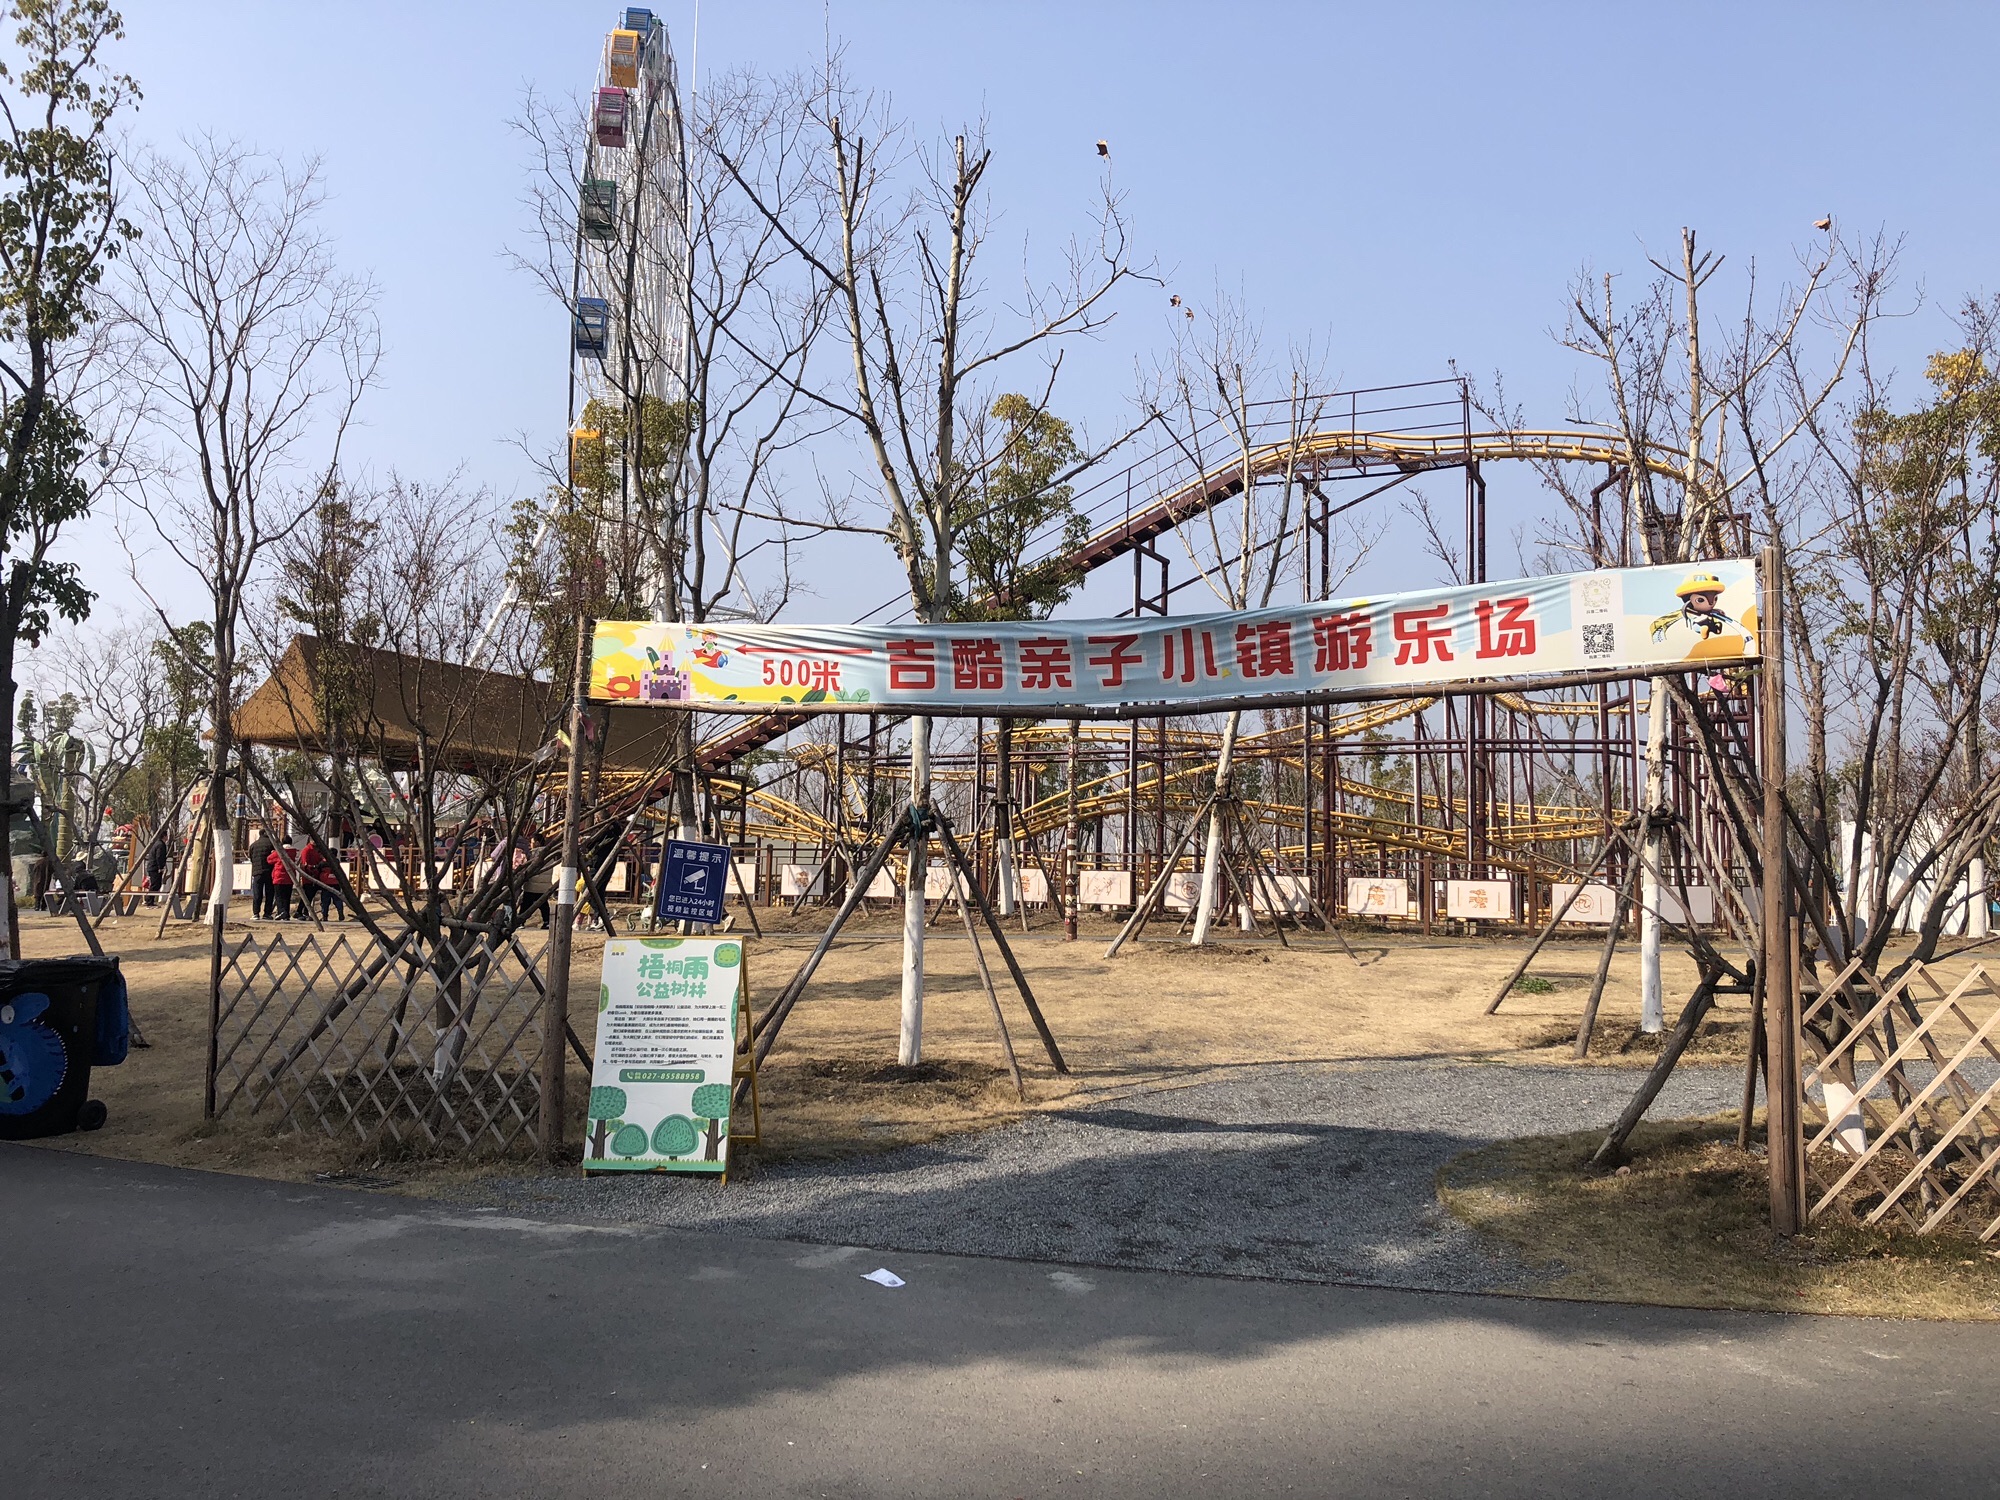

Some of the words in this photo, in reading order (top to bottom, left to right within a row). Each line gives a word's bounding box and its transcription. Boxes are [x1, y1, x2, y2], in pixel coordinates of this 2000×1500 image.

[886, 596, 1536, 691] 吉酷亲子小镇游乐场
[762, 658, 841, 692] 500米
[673, 848, 722, 863] 温馨提示
[668, 894, 715, 908] 您已进入24小时
[667, 904, 714, 918] 视频监控区域
[637, 953, 709, 979] 梧桐雨
[636, 980, 707, 999] 公益树林
